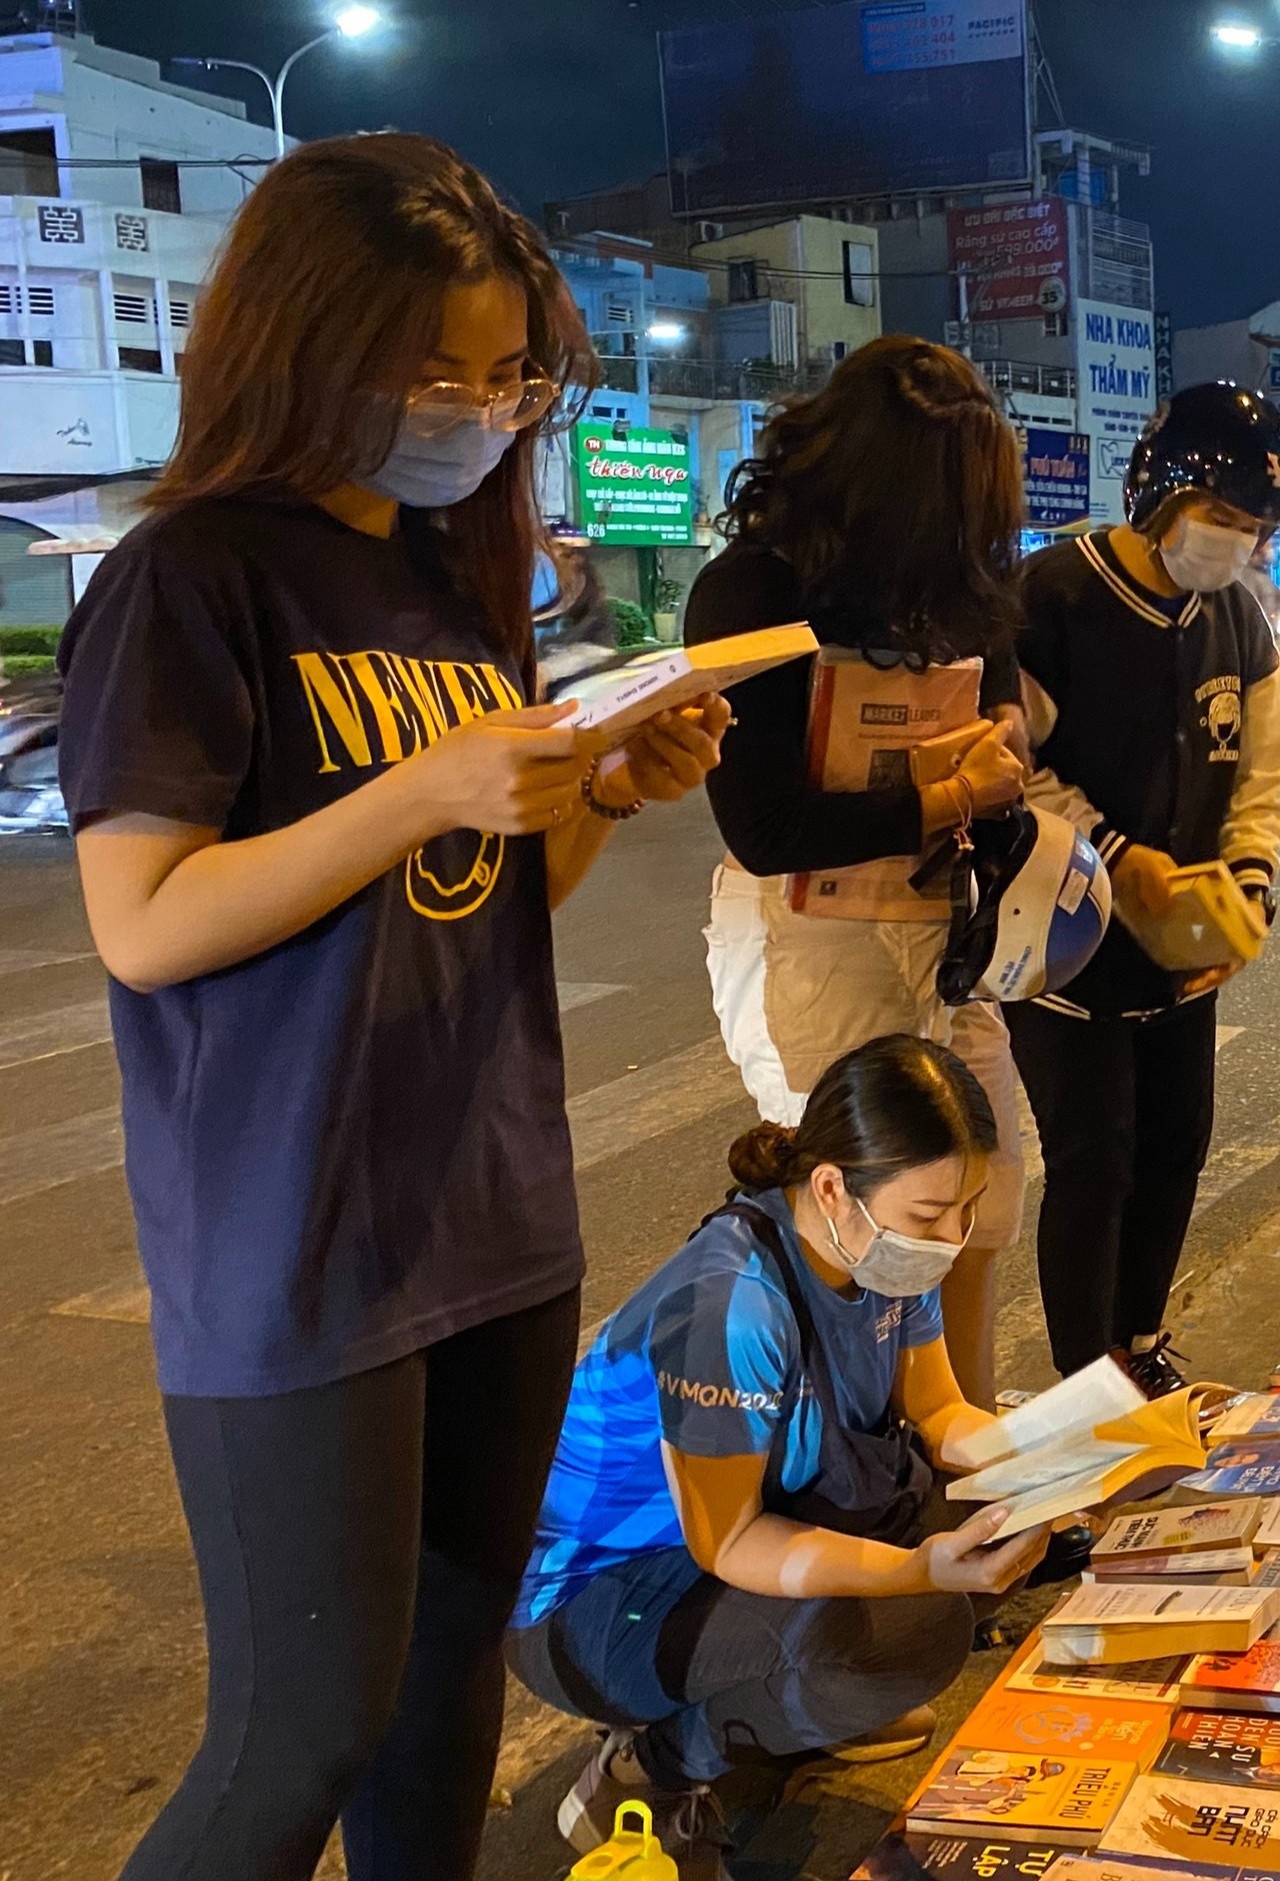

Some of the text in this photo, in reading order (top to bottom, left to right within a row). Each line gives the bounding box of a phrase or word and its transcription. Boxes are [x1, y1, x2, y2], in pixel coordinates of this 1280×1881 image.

[967, 17, 1015, 30] PACIFIC
[1085, 313, 1151, 351] NHA KHOA
[1089, 354, 1129, 397] THẨM
[862, 706, 907, 723] MARKET
